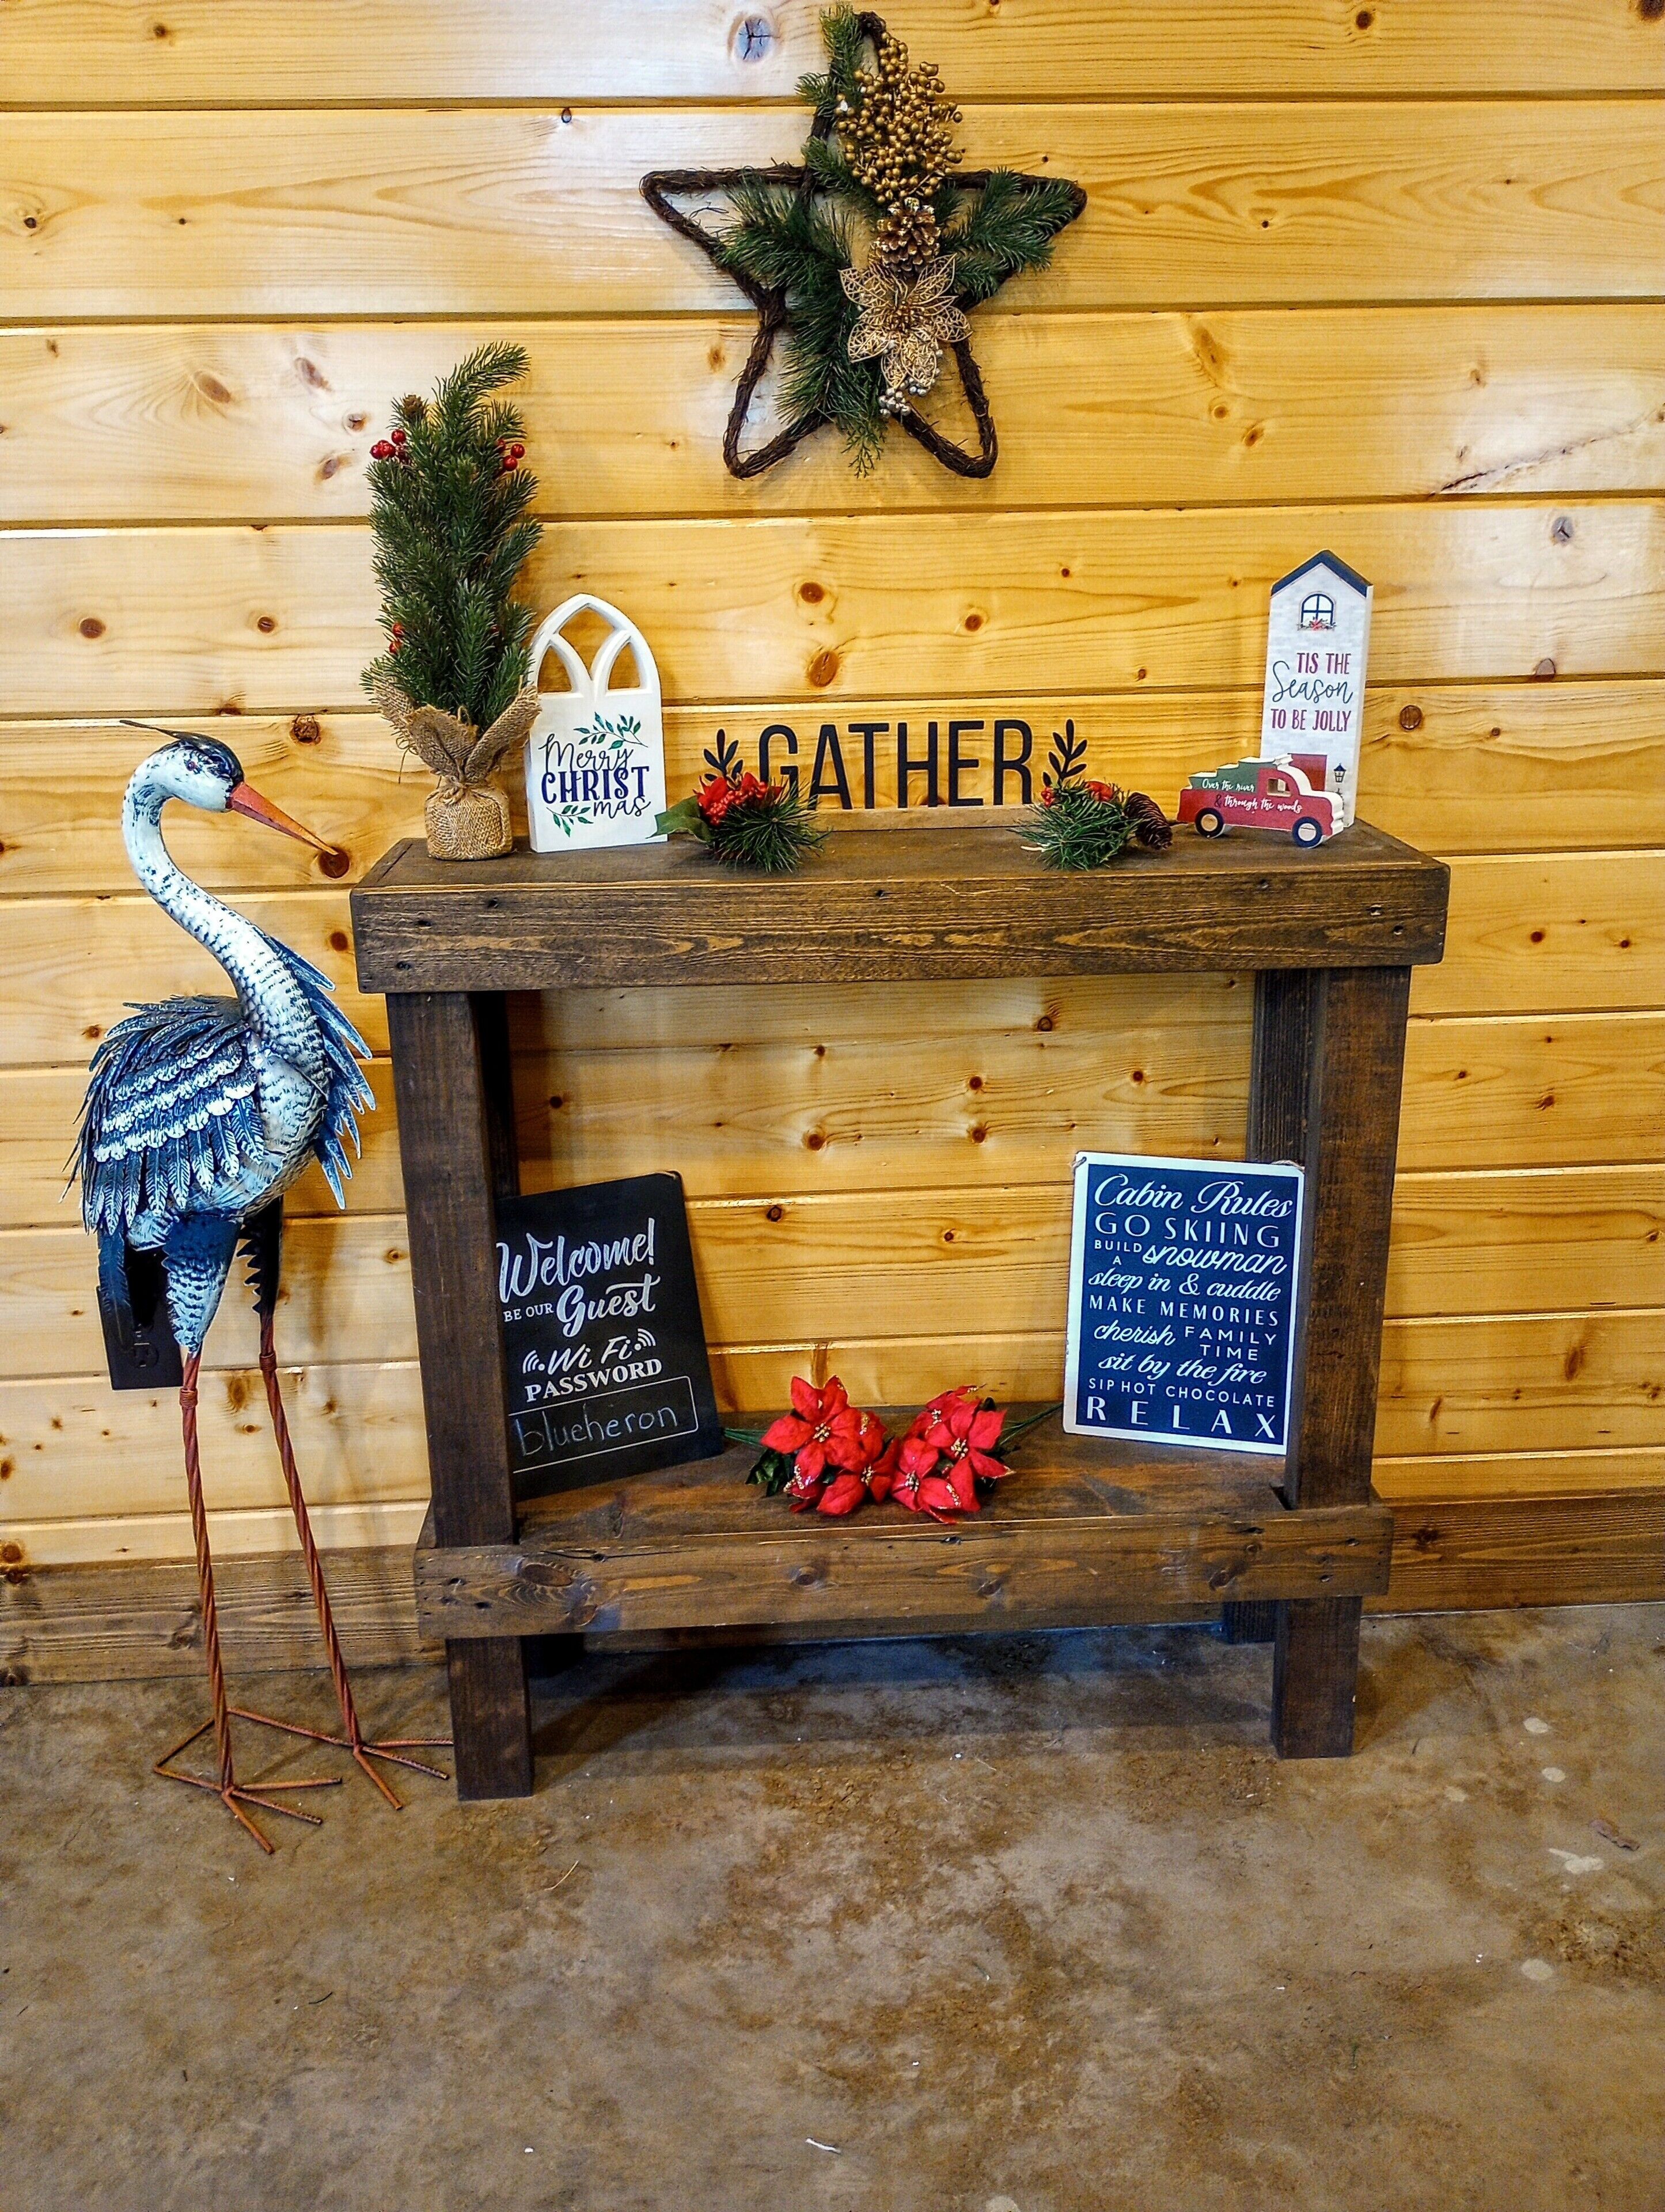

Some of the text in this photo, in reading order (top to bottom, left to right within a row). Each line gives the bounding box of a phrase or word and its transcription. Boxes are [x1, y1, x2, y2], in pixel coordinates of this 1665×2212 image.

[1297, 653, 1351, 675] TIS THE
[1272, 660, 1353, 704] Season
[1270, 709, 1352, 732] TO BE JOLLY
[538, 733, 634, 779] Merry
[758, 719, 1034, 810] GATHER
[541, 766, 650, 804] CHRIST
[1202, 778, 1255, 793] Over the river
[593, 796, 651, 819] mas
[1215, 794, 1303, 814] & through the woods
[1095, 1173, 1293, 1218] Cabin Rules
[1095, 1212, 1279, 1248] GO SKIING
[1095, 1240, 1142, 1253] BUILD
[496, 1217, 655, 1303] Welcome!
[1112, 1255, 1122, 1265] A
[1142, 1244, 1287, 1275] snowman
[1088, 1267, 1281, 1302] sleep in & cuddle
[503, 1273, 661, 1338] BE OUR Guest
[1089, 1295, 1279, 1326] MAKE MEMORIES
[1094, 1319, 1277, 1346] cherish FAMILY
[547, 1335, 632, 1375] Wi Fi
[1200, 1344, 1258, 1361] TIME
[525, 1358, 662, 1403] PASSWORD
[1098, 1353, 1267, 1387] sit by the fire
[1088, 1378, 1275, 1408] SIP HOT CHOCOLATE
[514, 1402, 679, 1456] blueheron
[1086, 1396, 1276, 1438] RELAX
